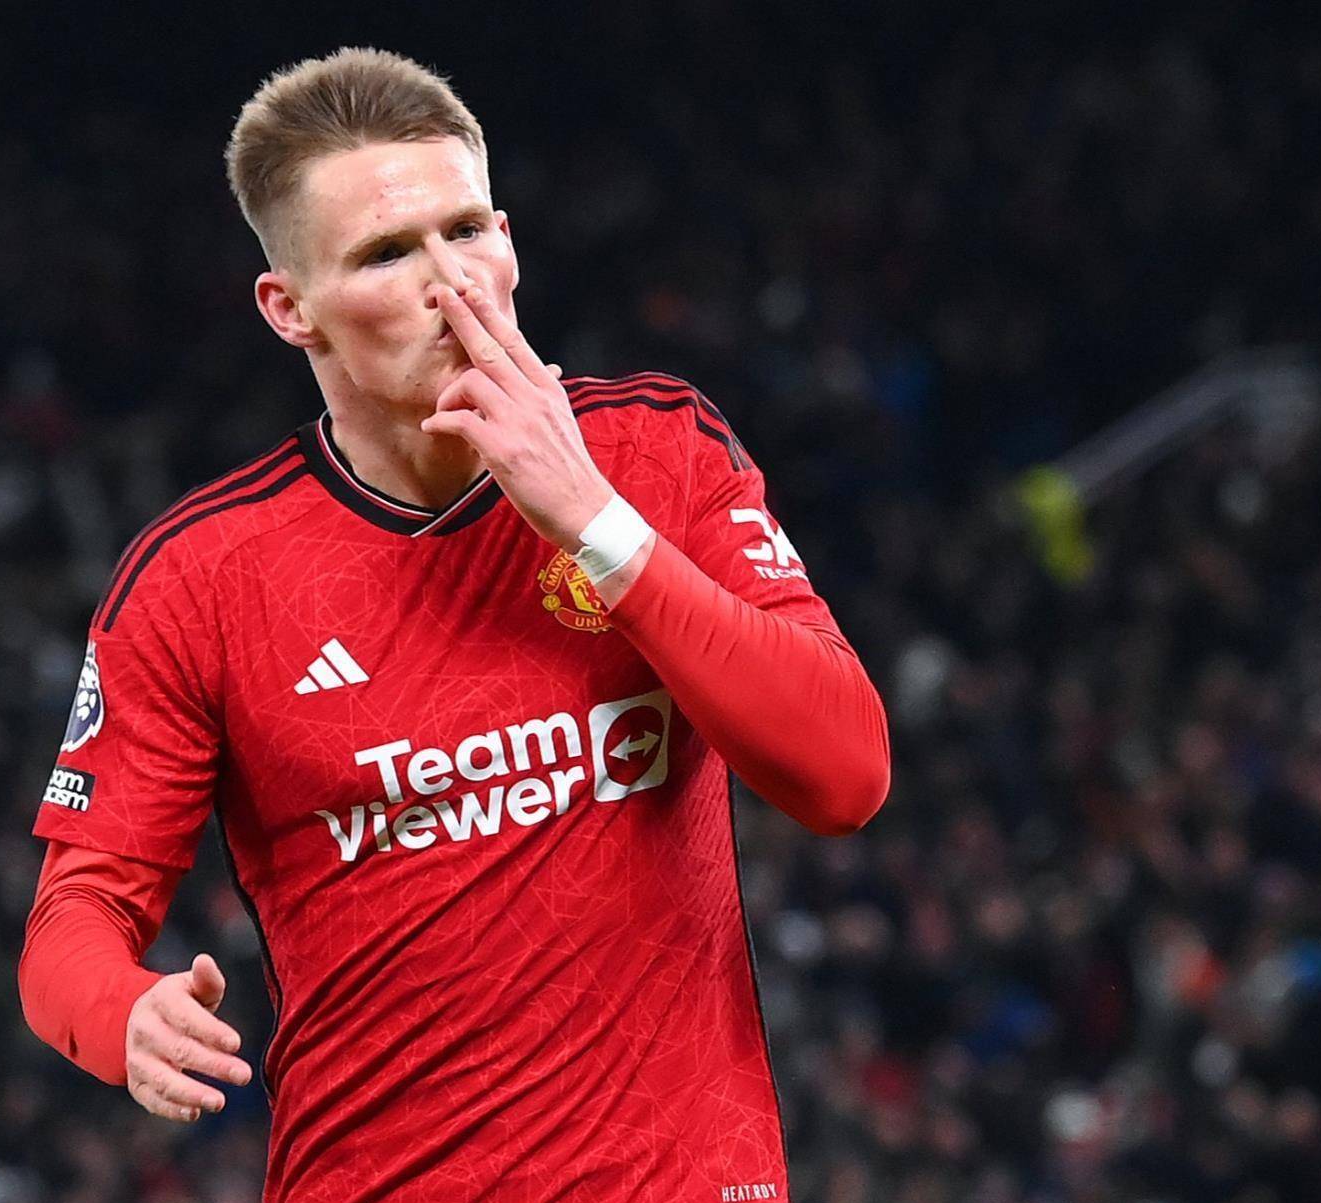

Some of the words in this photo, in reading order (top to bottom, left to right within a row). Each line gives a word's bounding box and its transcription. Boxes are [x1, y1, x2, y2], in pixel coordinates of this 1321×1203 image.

[355, 712, 582, 803] Team
[318, 766, 585, 862] Viewer
[722, 1183, 777, 1203] HEAT.RDY
